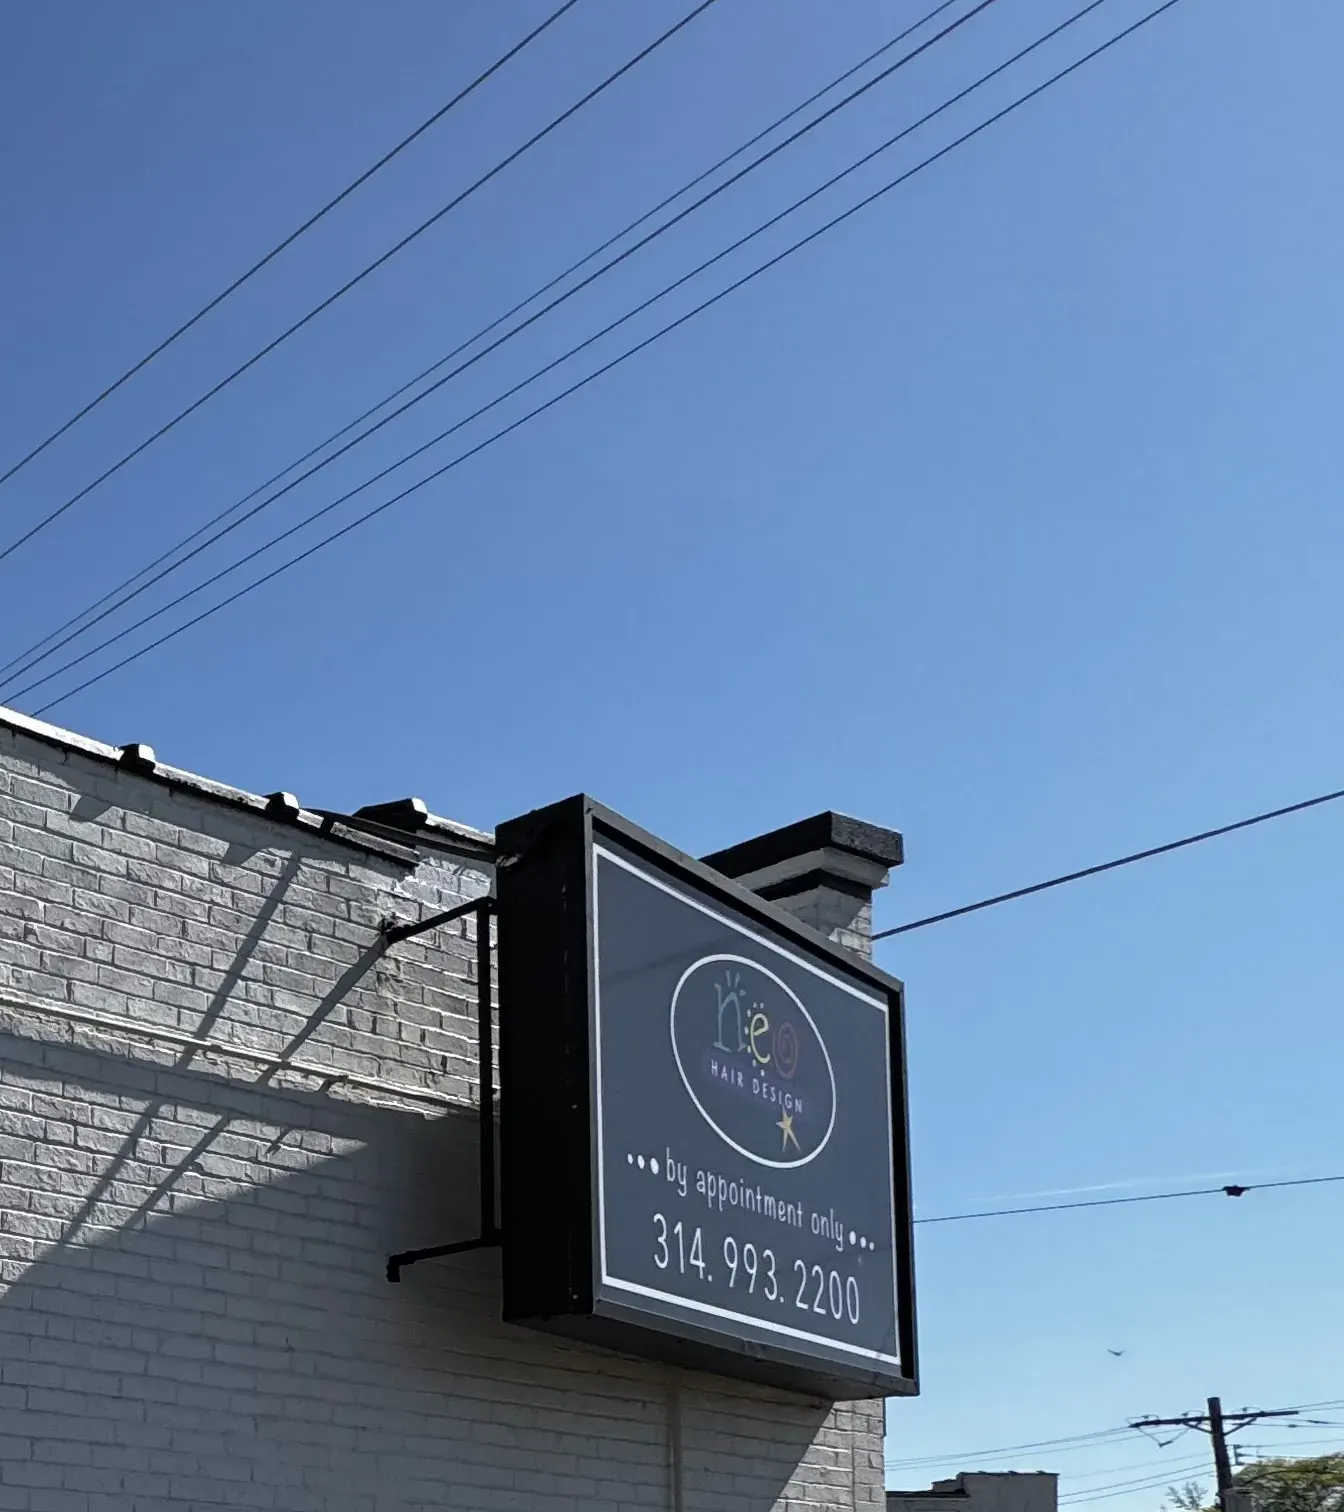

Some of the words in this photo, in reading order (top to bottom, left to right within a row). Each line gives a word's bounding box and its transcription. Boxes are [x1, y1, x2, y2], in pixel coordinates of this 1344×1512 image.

[710, 1058, 744, 1089] HAIR
[752, 1078, 803, 1114] DESIGN
[696, 1170, 803, 1228] appointment
